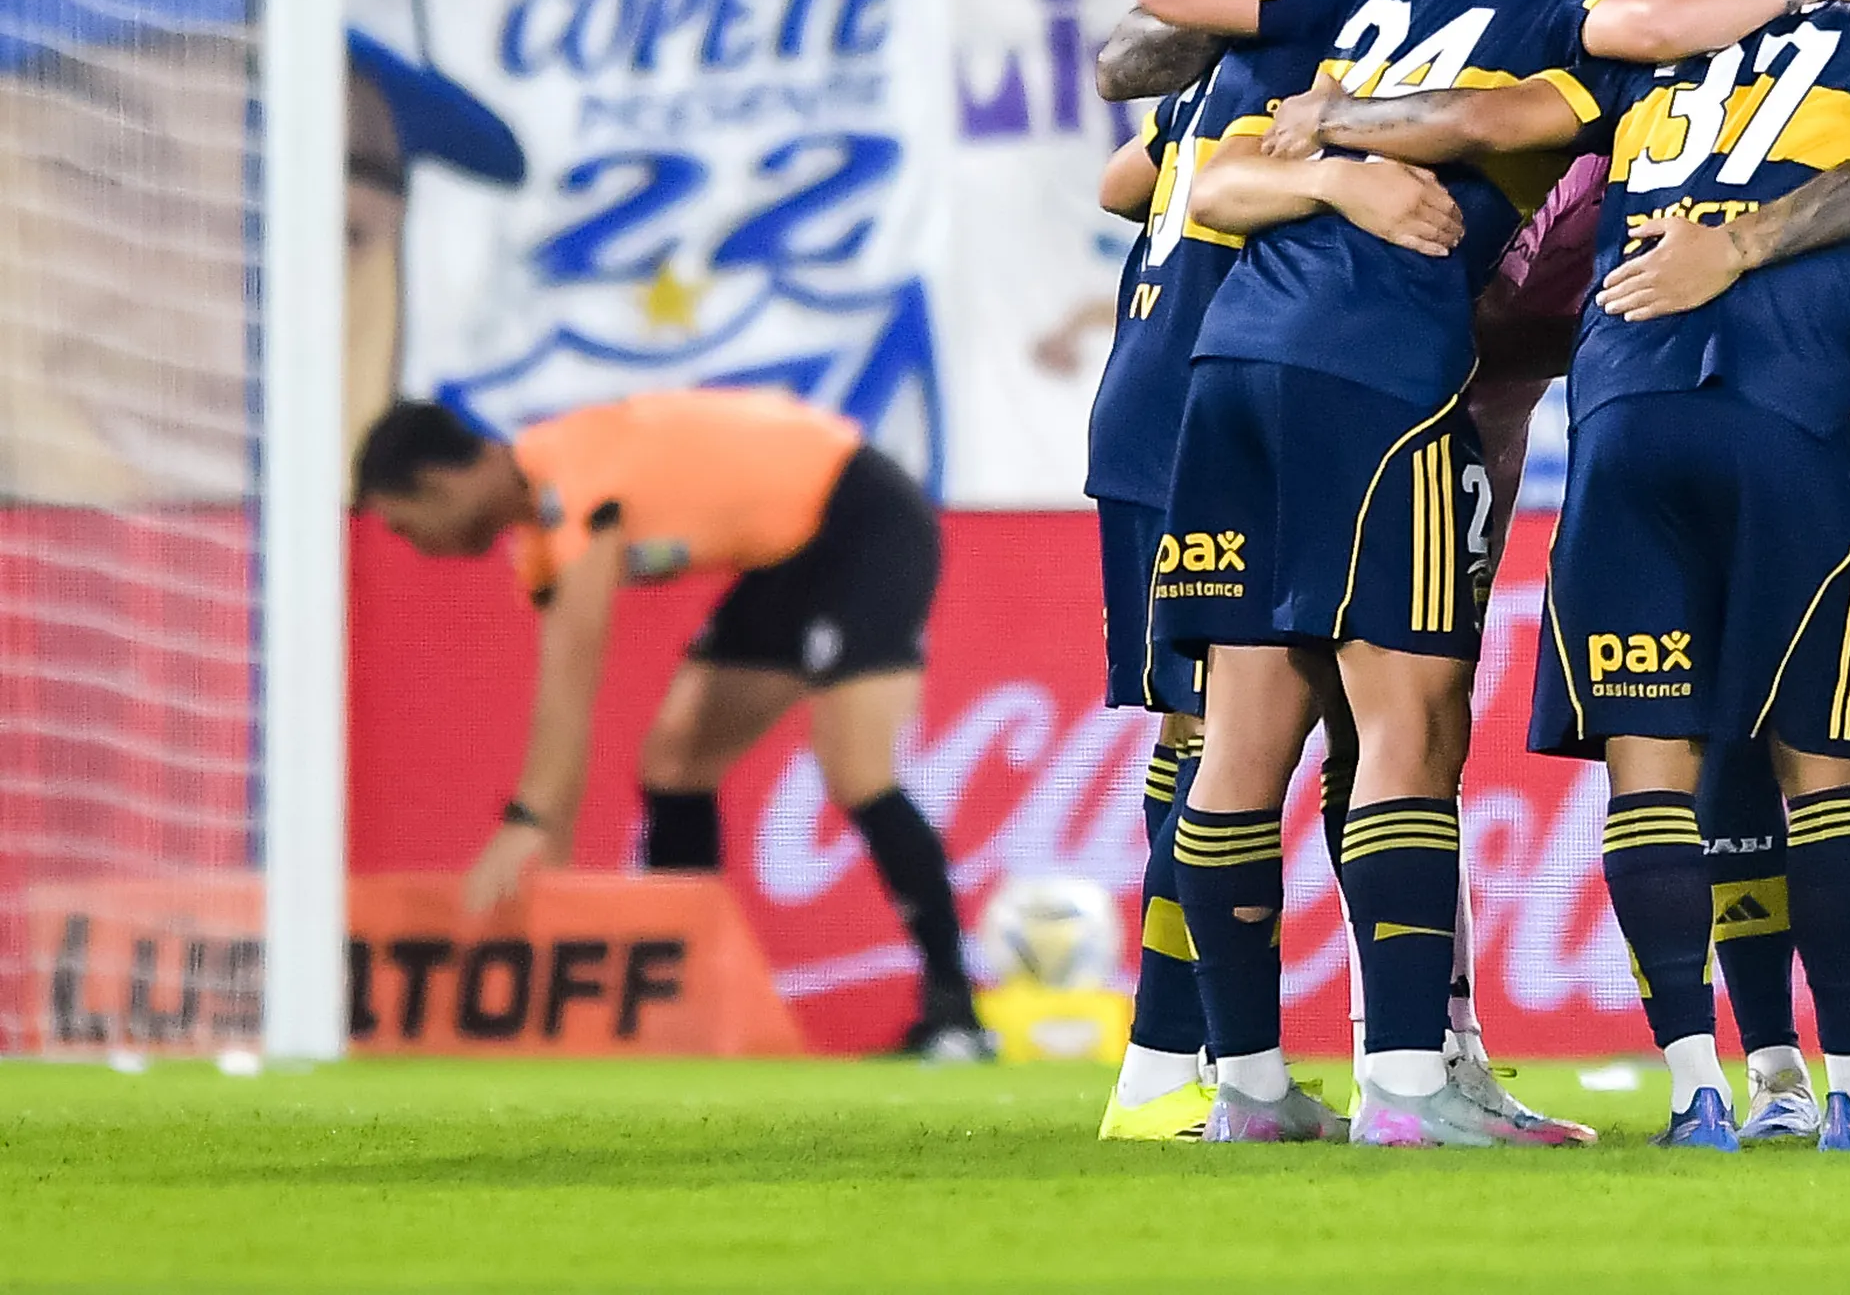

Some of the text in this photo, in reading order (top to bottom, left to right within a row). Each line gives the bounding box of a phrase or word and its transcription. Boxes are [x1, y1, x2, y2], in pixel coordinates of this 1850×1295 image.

[1627, 21, 1843, 193] 37
[530, 130, 905, 287] 22
[1588, 630, 1692, 682] pax
[1592, 682, 1692, 698] assistance
